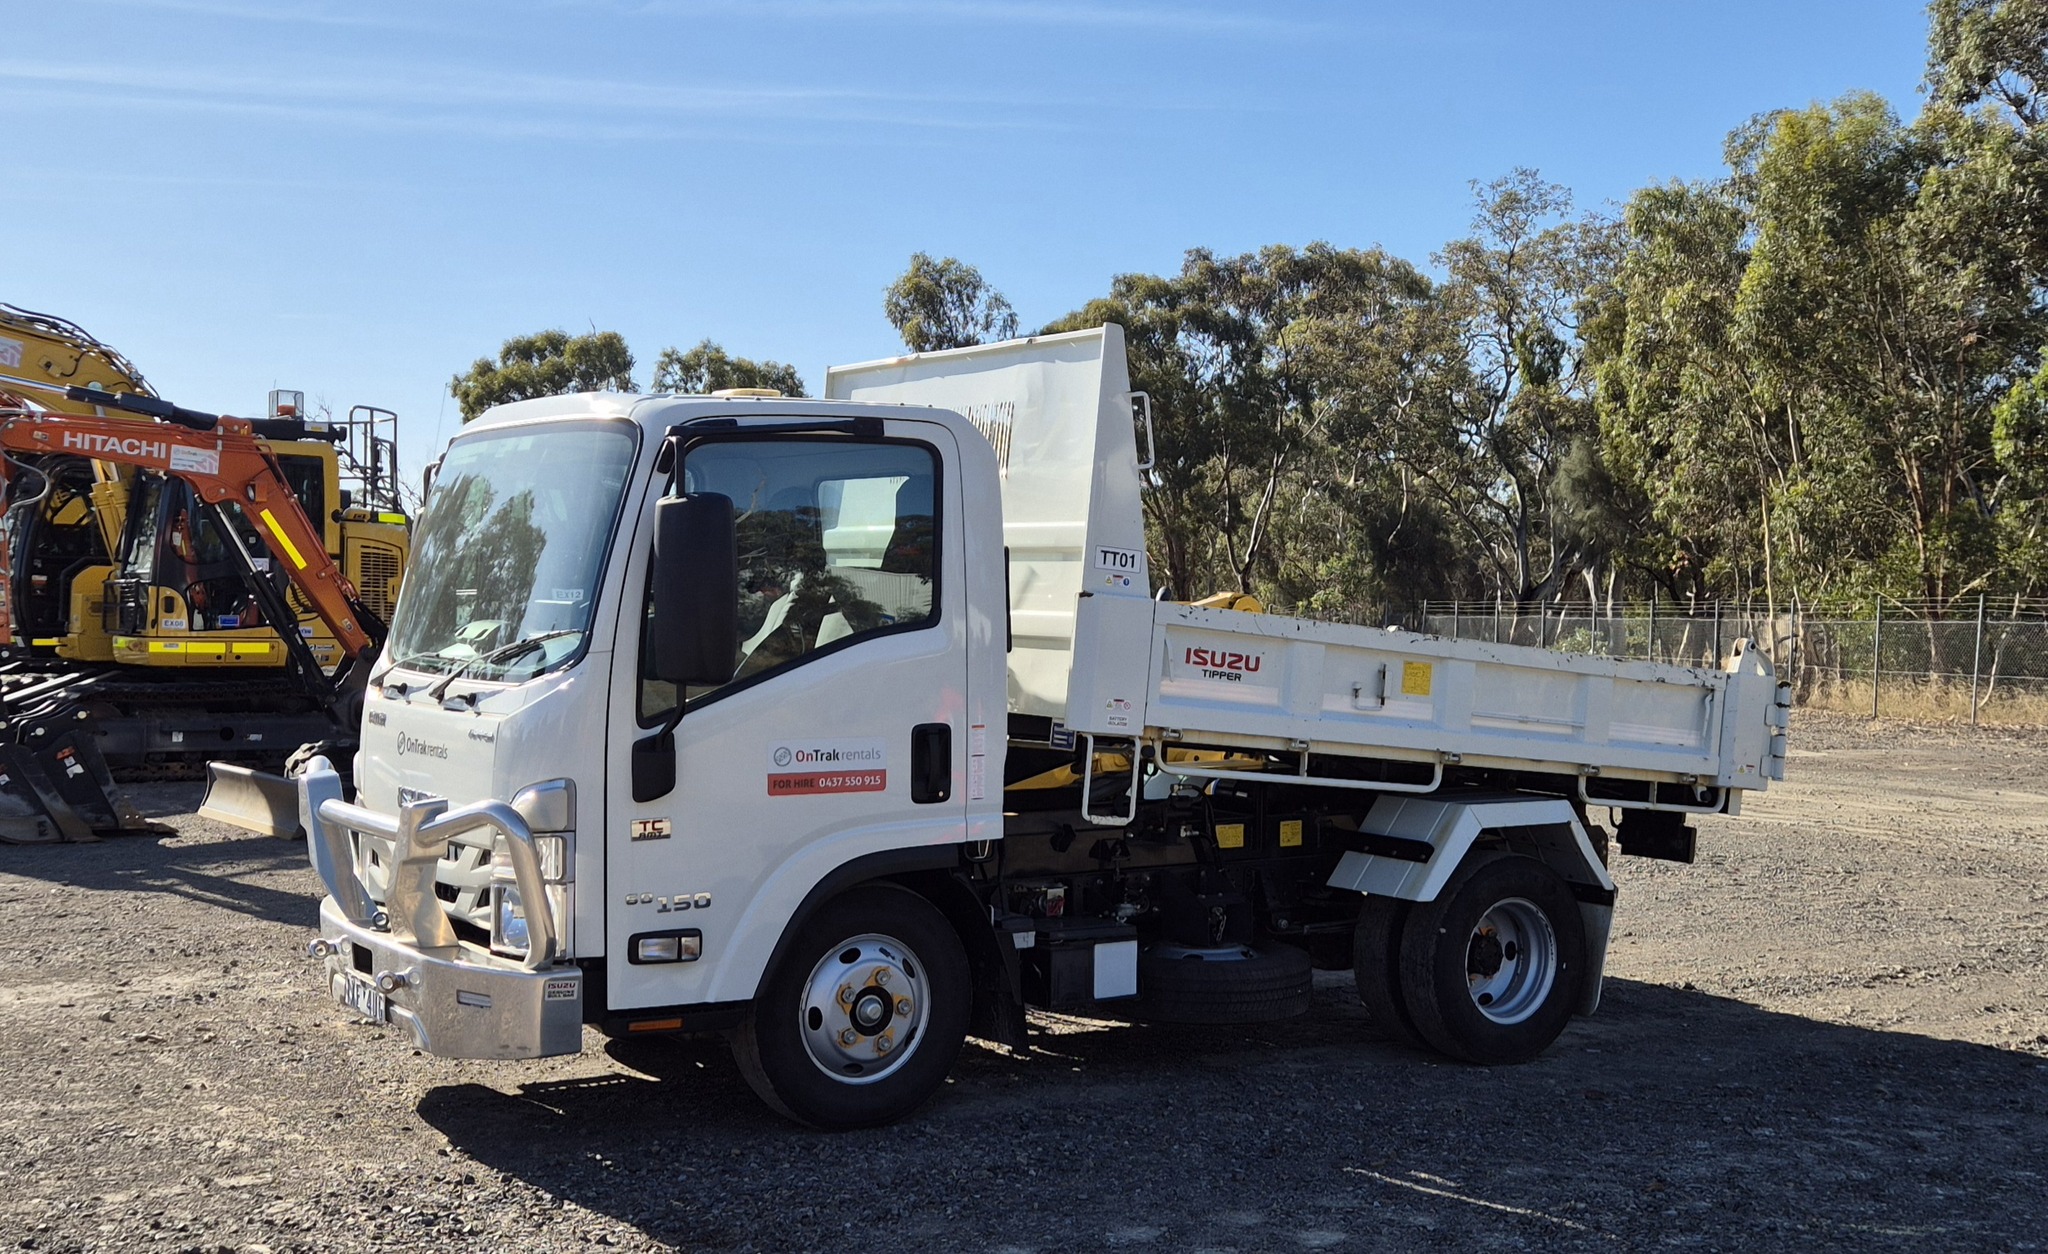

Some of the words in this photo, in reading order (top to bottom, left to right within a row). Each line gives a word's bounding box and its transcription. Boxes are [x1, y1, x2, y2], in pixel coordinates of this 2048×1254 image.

[63, 431, 166, 459] HITACHI
[1100, 549, 1135, 568] TT01
[1185, 647, 1261, 672] ISUZU
[1202, 669, 1242, 681] TIPPER
[406, 737, 427, 756] OnTrak
[427, 744, 448, 760] rentals
[795, 748, 840, 763] OnTrak
[841, 747, 881, 760] rentals
[773, 779, 792, 789] FOR
[794, 778, 814, 788] HIRE
[819, 776, 842, 788] 0437
[845, 776, 862, 786] 550
[864, 775, 881, 785] 915
[639, 820, 664, 832] TC
[657, 892, 712, 913] 150
